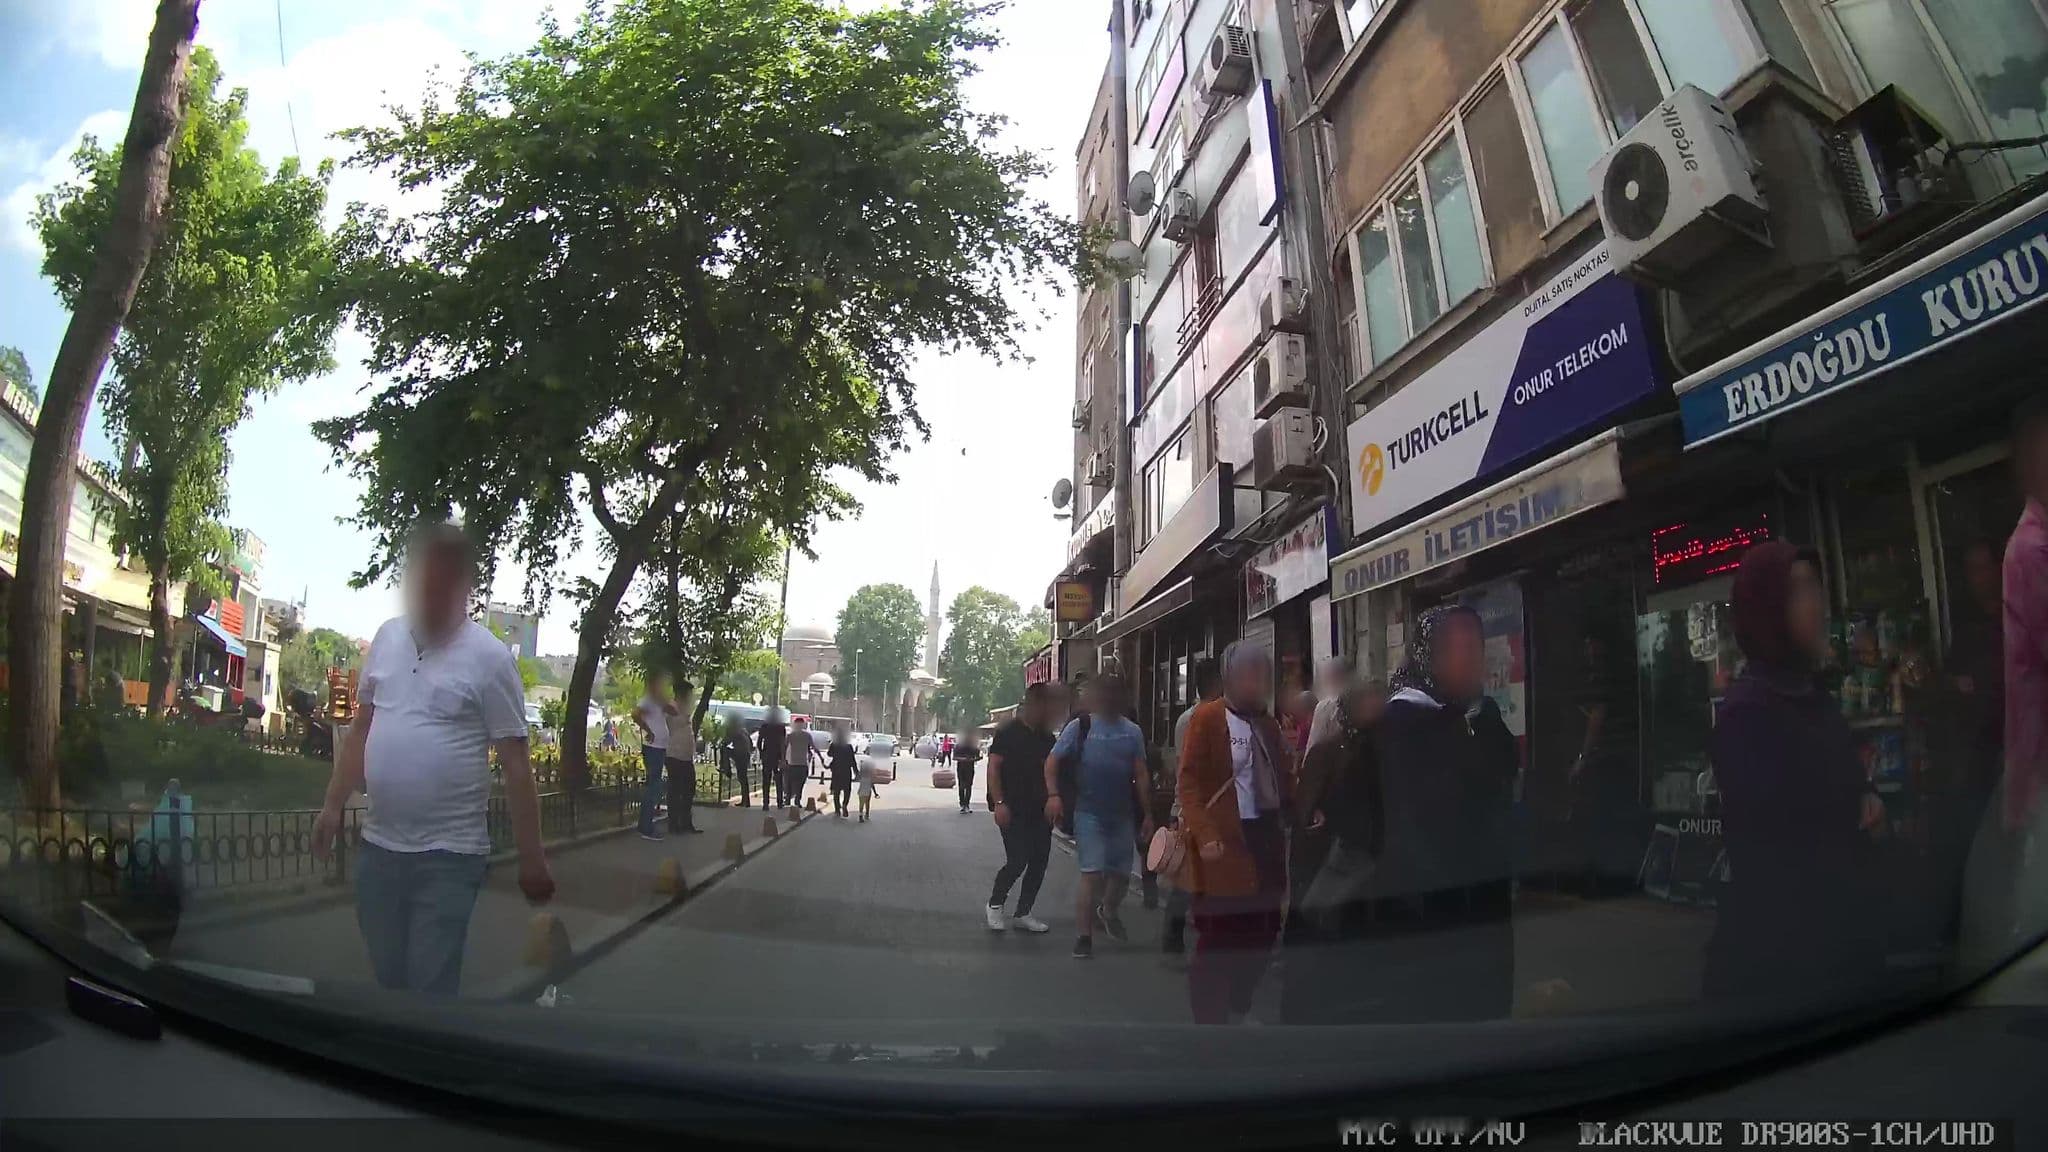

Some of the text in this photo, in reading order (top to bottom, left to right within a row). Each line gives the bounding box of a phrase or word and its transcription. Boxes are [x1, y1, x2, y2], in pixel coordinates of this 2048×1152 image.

[1661, 103, 1699, 172] arçelik
[1551, 277, 1574, 299] SATIŞ
[1573, 247, 1611, 282] NOKTASI
[1514, 322, 1629, 406] ONUR TELEKOM
[1723, 312, 1892, 424] ERDOĞDU
[1387, 389, 1489, 470] TURKCELL
[1344, 548, 1411, 593] ONUR
[1679, 818, 1722, 835] ONUR
